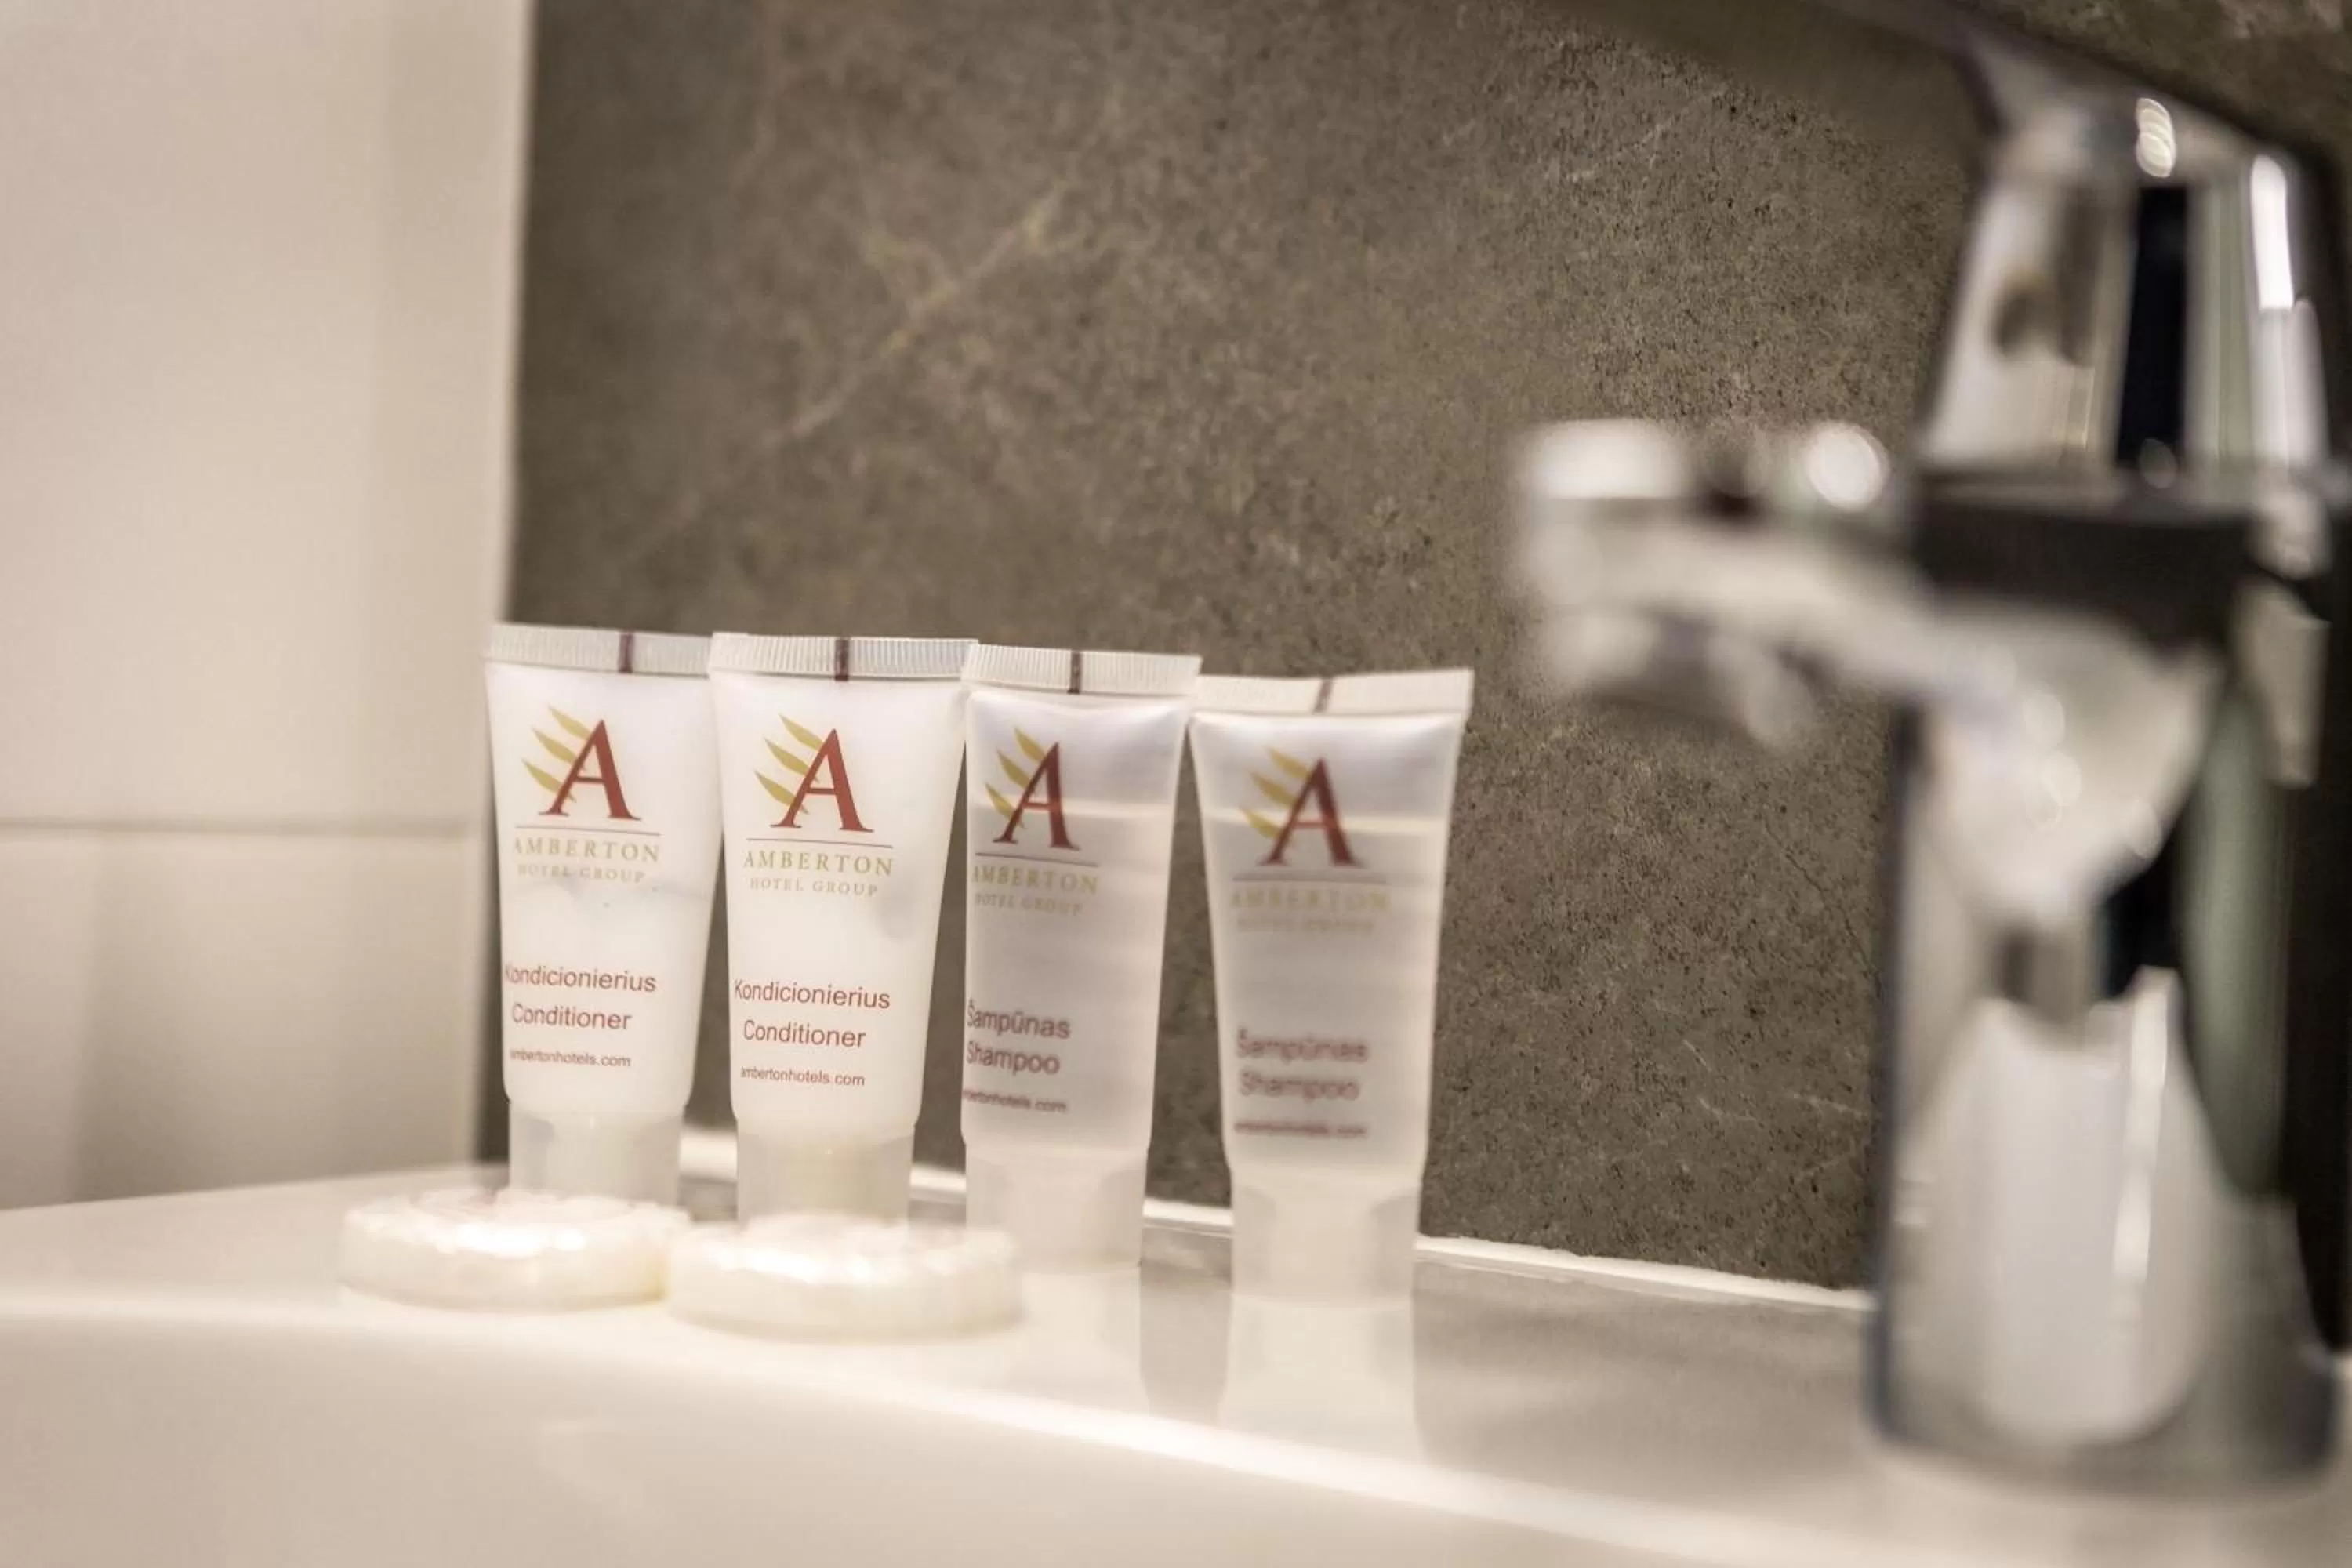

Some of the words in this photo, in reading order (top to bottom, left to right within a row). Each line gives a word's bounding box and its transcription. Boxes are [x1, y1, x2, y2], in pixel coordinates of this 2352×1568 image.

[538, 718, 642, 822] A
[769, 728, 875, 833] A
[992, 742, 1081, 851] A
[1254, 757, 1368, 869] A
[514, 837, 660, 863] AMBERTON
[743, 850, 894, 877] AMBERTON
[750, 877, 804, 891] HOTEL
[812, 881, 878, 897] GROUP
[734, 979, 891, 1009] Kondicionierius
[512, 1003, 633, 1029] Conditioner
[743, 1019, 866, 1048] Conditioner
[966, 1040, 1060, 1076] Shampoo
